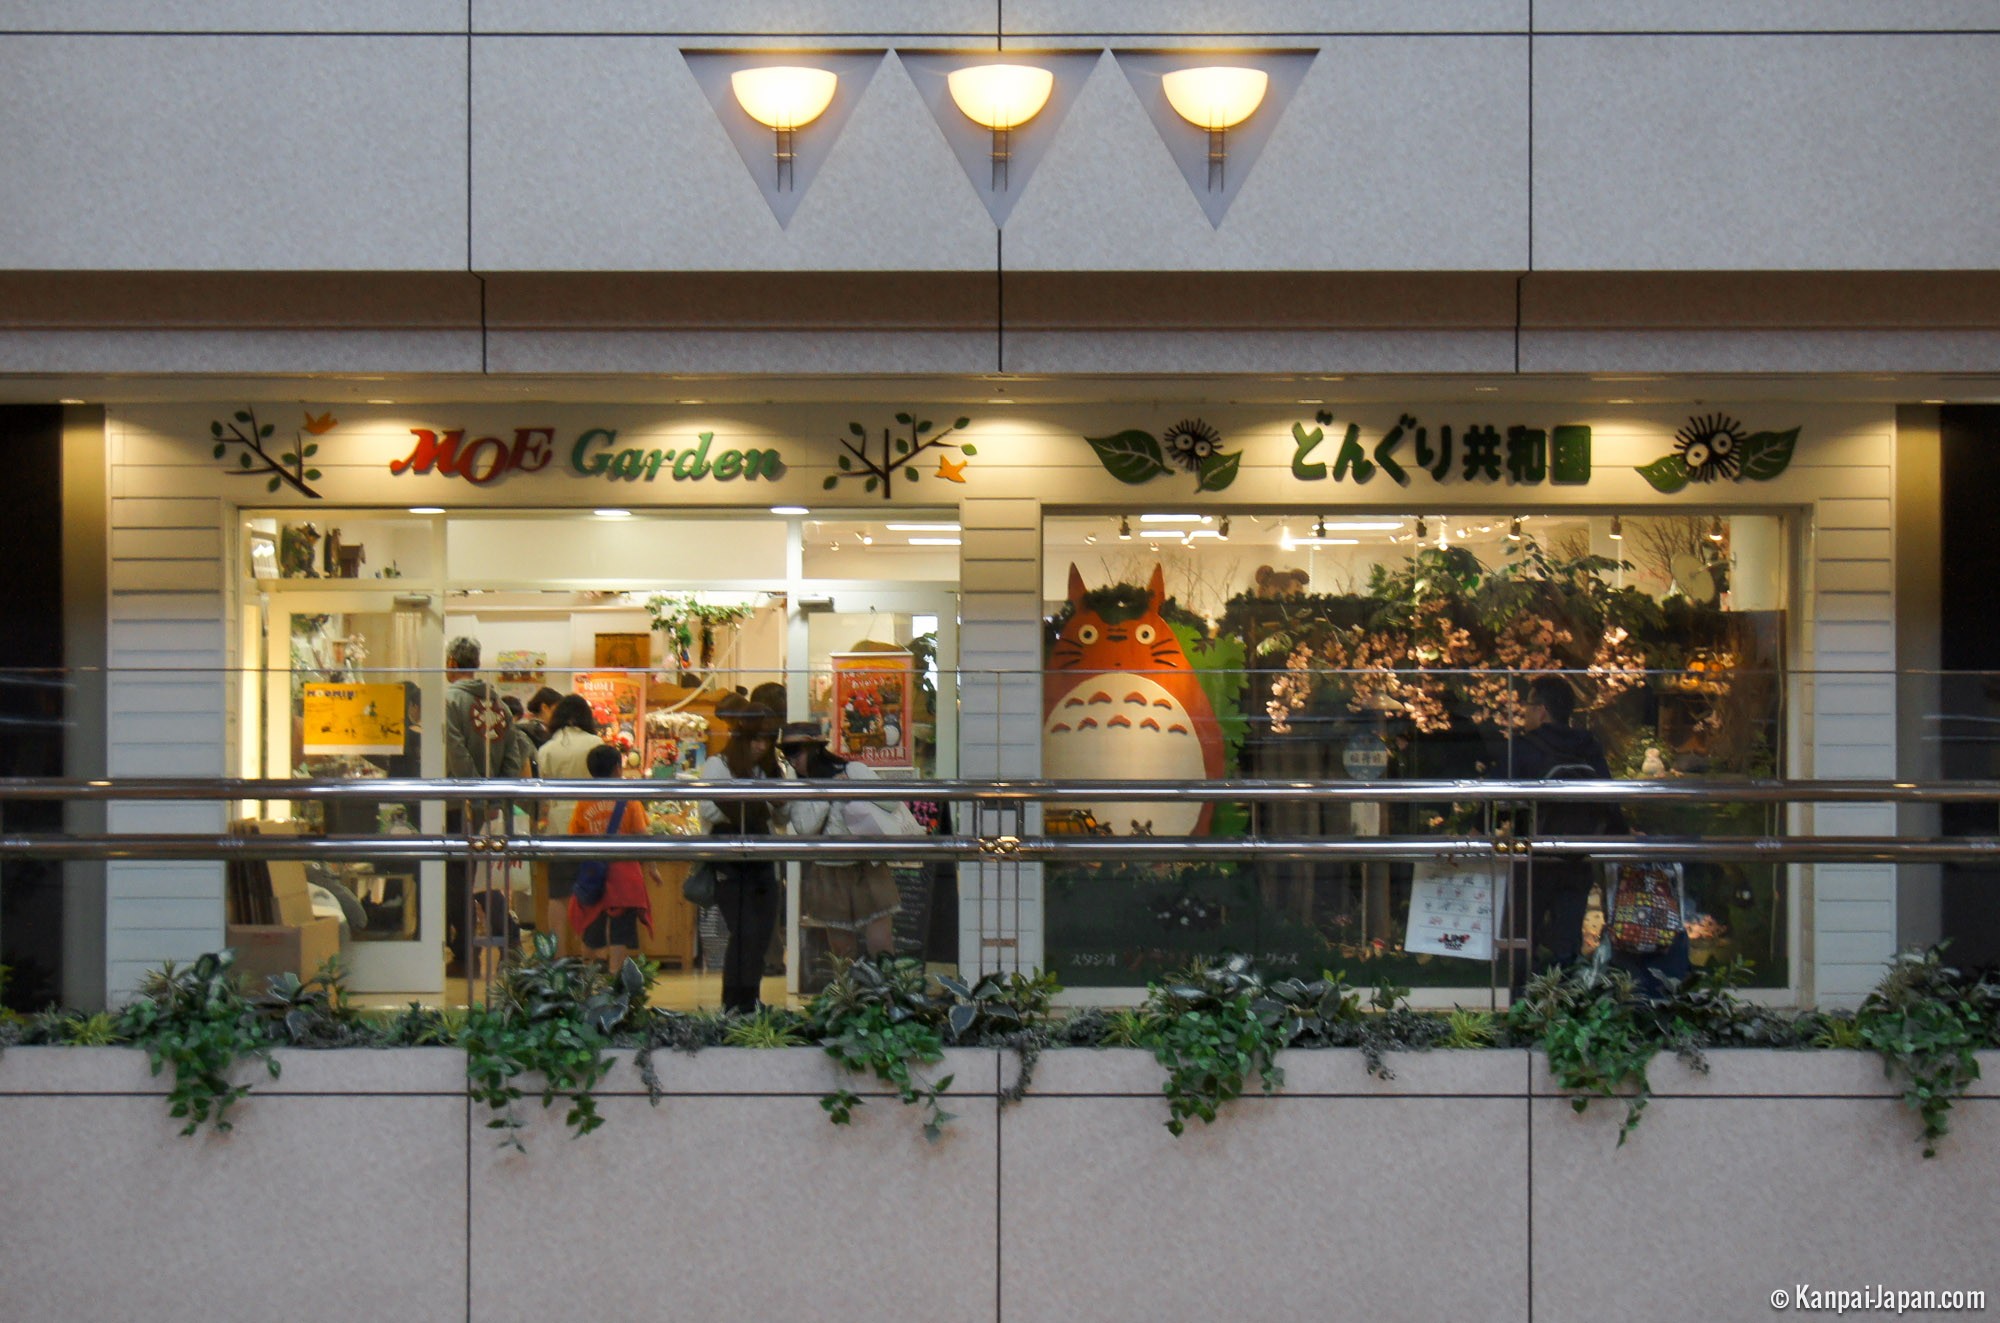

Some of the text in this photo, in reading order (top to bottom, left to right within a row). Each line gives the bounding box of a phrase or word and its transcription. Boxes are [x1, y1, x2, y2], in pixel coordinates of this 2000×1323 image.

[390, 428, 781, 484] MOE Garden
[1291, 410, 1591, 484] どんぐり共和国
